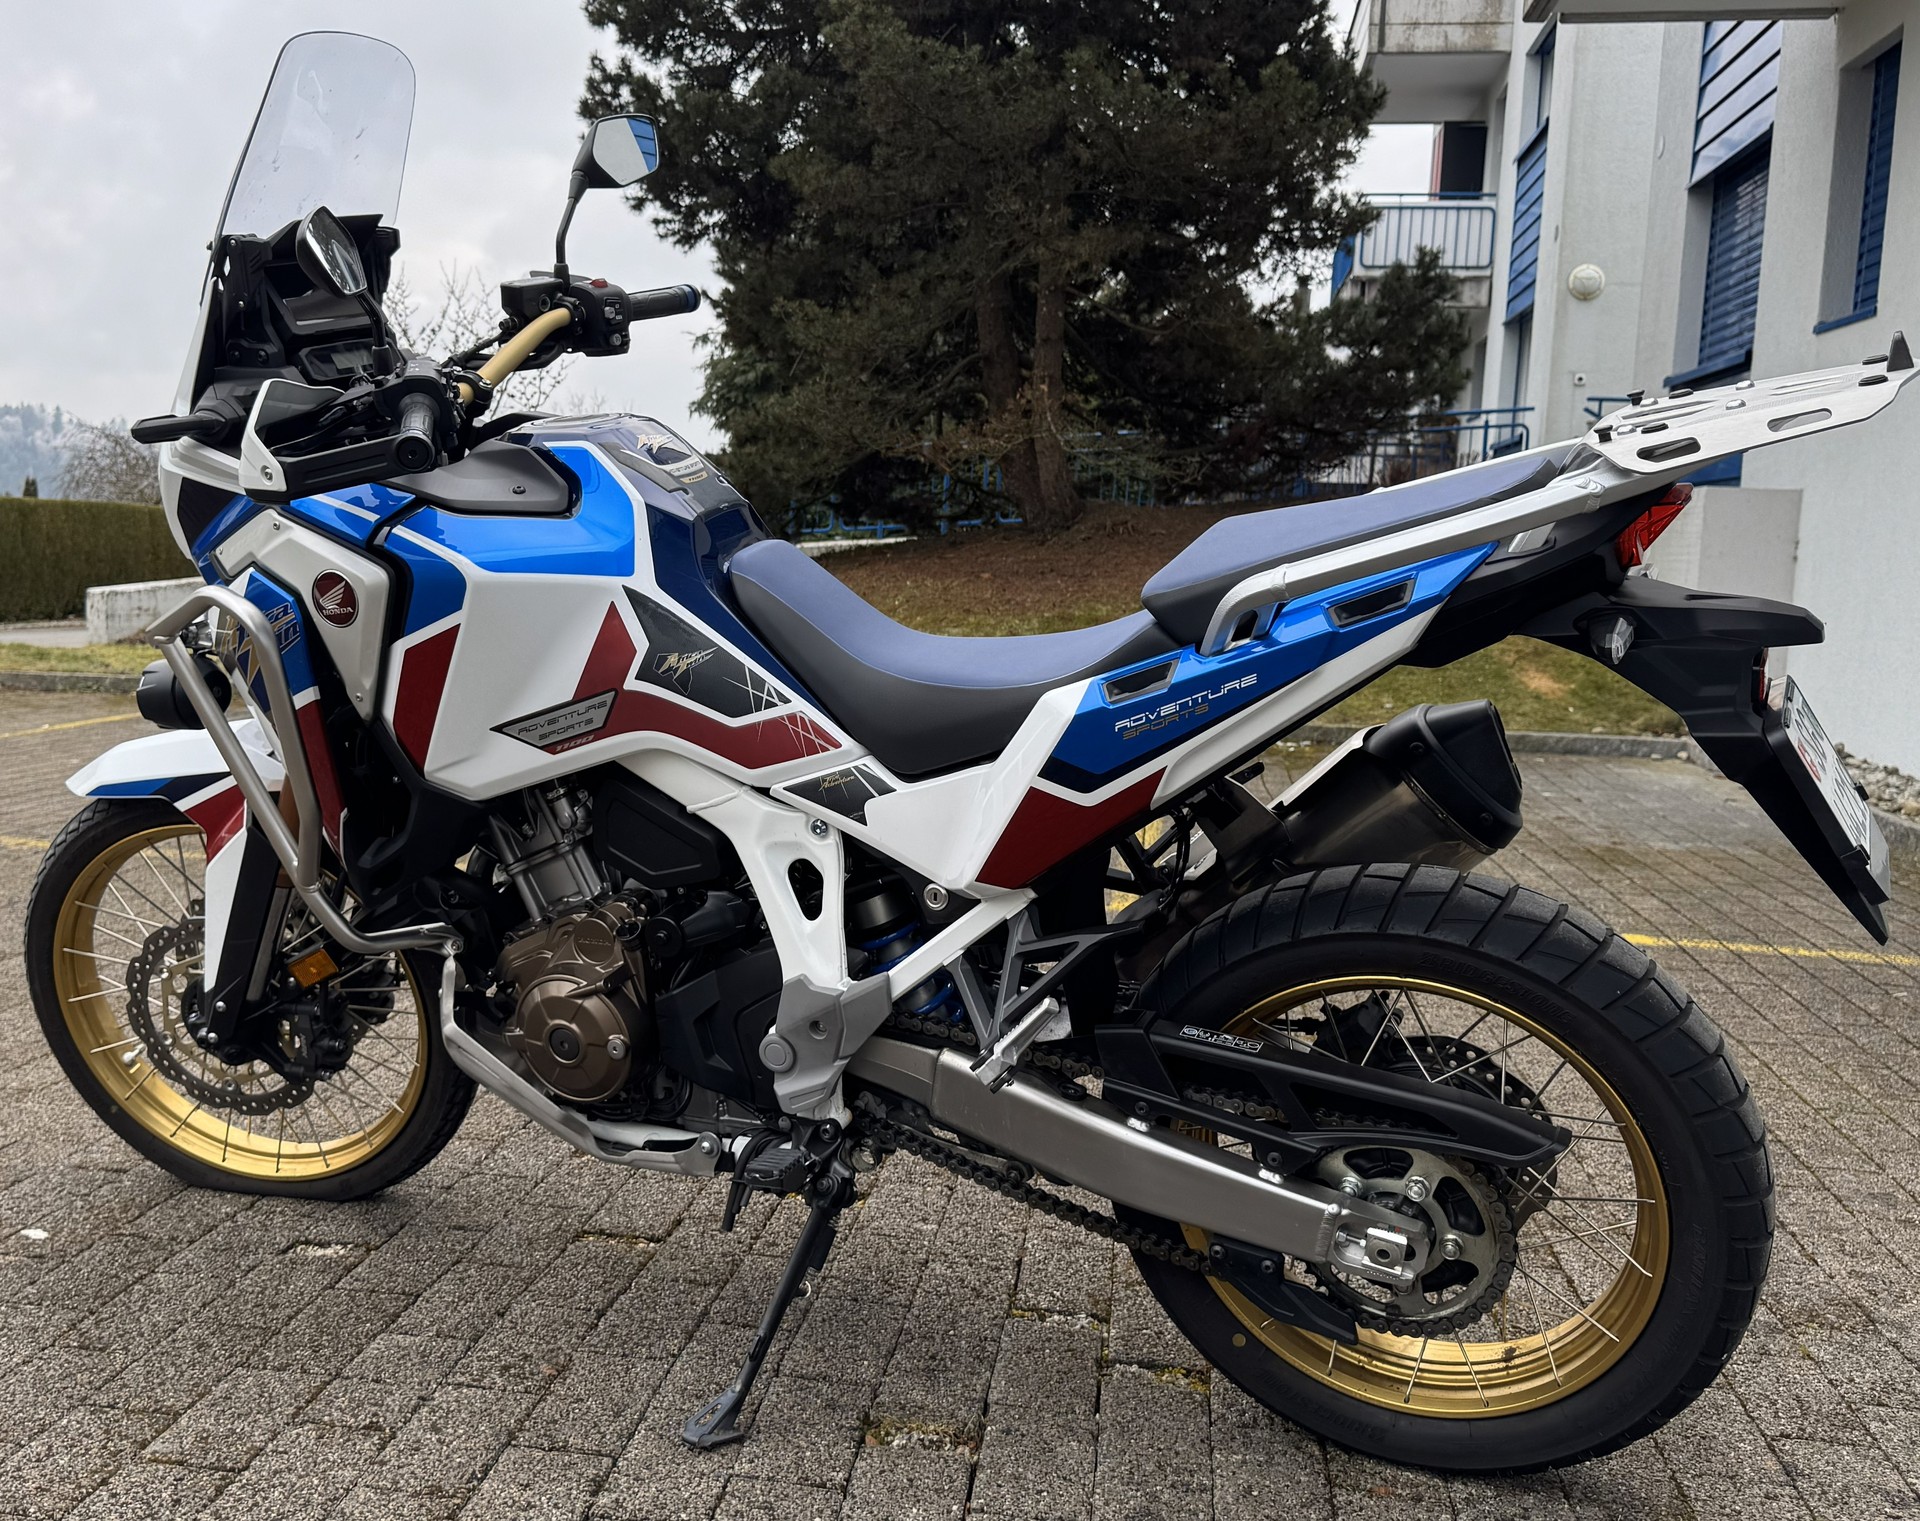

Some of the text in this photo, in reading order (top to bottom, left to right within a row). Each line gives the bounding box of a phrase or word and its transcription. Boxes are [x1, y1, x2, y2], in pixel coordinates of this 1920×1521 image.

[322, 607, 354, 617] HONDA
[517, 699, 608, 736] ADVENTURE
[1114, 673, 1258, 733] ADVENTURE
[1122, 703, 1209, 740] SPORTS
[538, 717, 594, 741] SPORTS
[555, 734, 595, 752] 1100
[1417, 951, 1577, 1025] BRIDGESTONE
